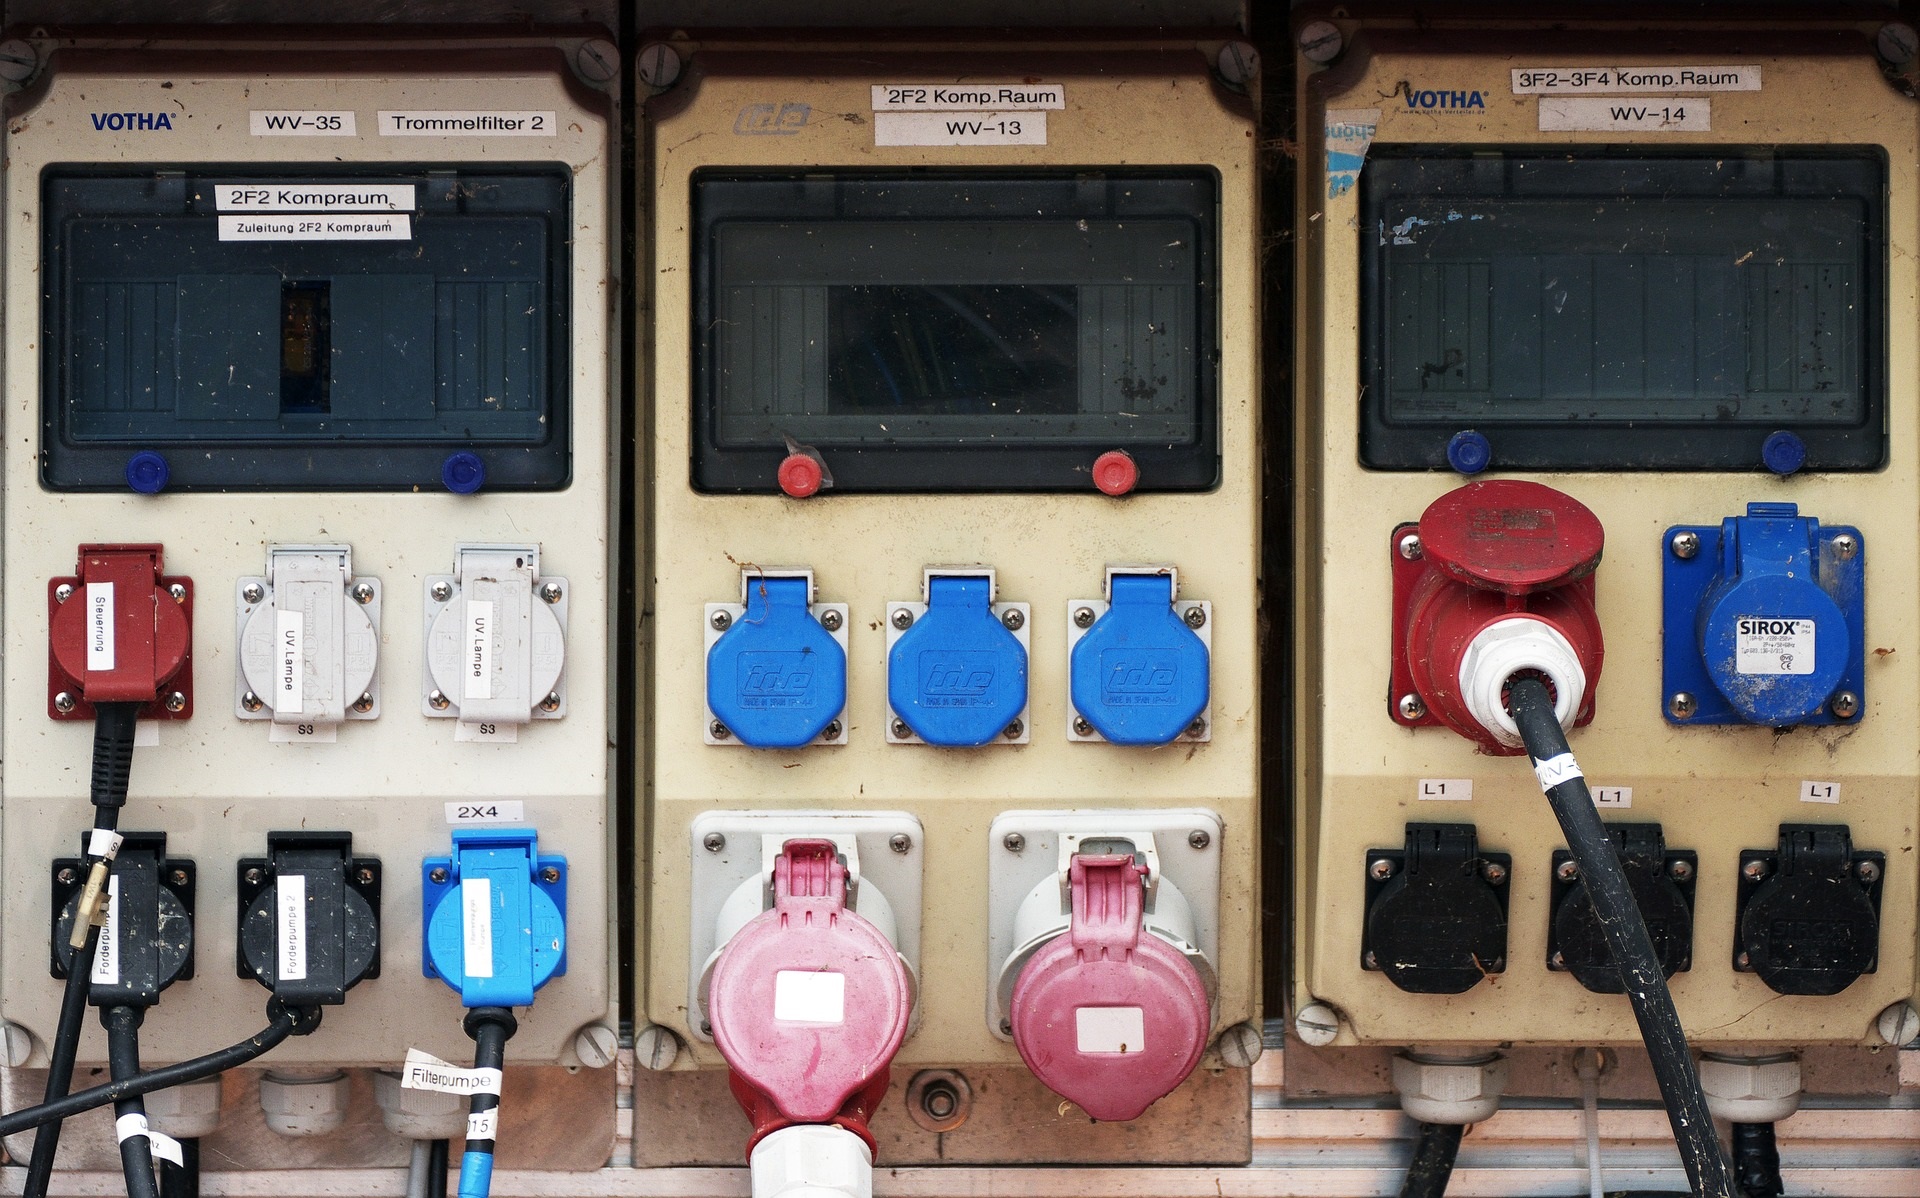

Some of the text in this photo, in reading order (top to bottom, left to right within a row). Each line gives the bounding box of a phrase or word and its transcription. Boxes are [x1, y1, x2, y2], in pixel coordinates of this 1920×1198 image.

[1519, 70, 1739, 88] 3F2-3F4 Komp.Raum
[888, 89, 1057, 106] 2F2 Komp.Raum
[1610, 106, 1687, 121] WV-14
[264, 115, 342, 131] WV-35
[391, 115, 544, 131] Trommelfilter 2
[946, 121, 1022, 135] WV-13
[231, 190, 389, 207] 2F2 Kompraum
[237, 222, 393, 234] Zuleitung 2F2 Kompraum
[94, 596, 106, 652] Steuerrung
[298, 724, 314, 735] S3
[479, 724, 496, 735] S3
[1424, 783, 1446, 795] L1
[1599, 790, 1622, 803] L1
[1810, 785, 1832, 798] L1
[457, 806, 499, 819] 2X4
[286, 905, 298, 974] Forderpumpe
[411, 1067, 491, 1090] Filterpumpe
